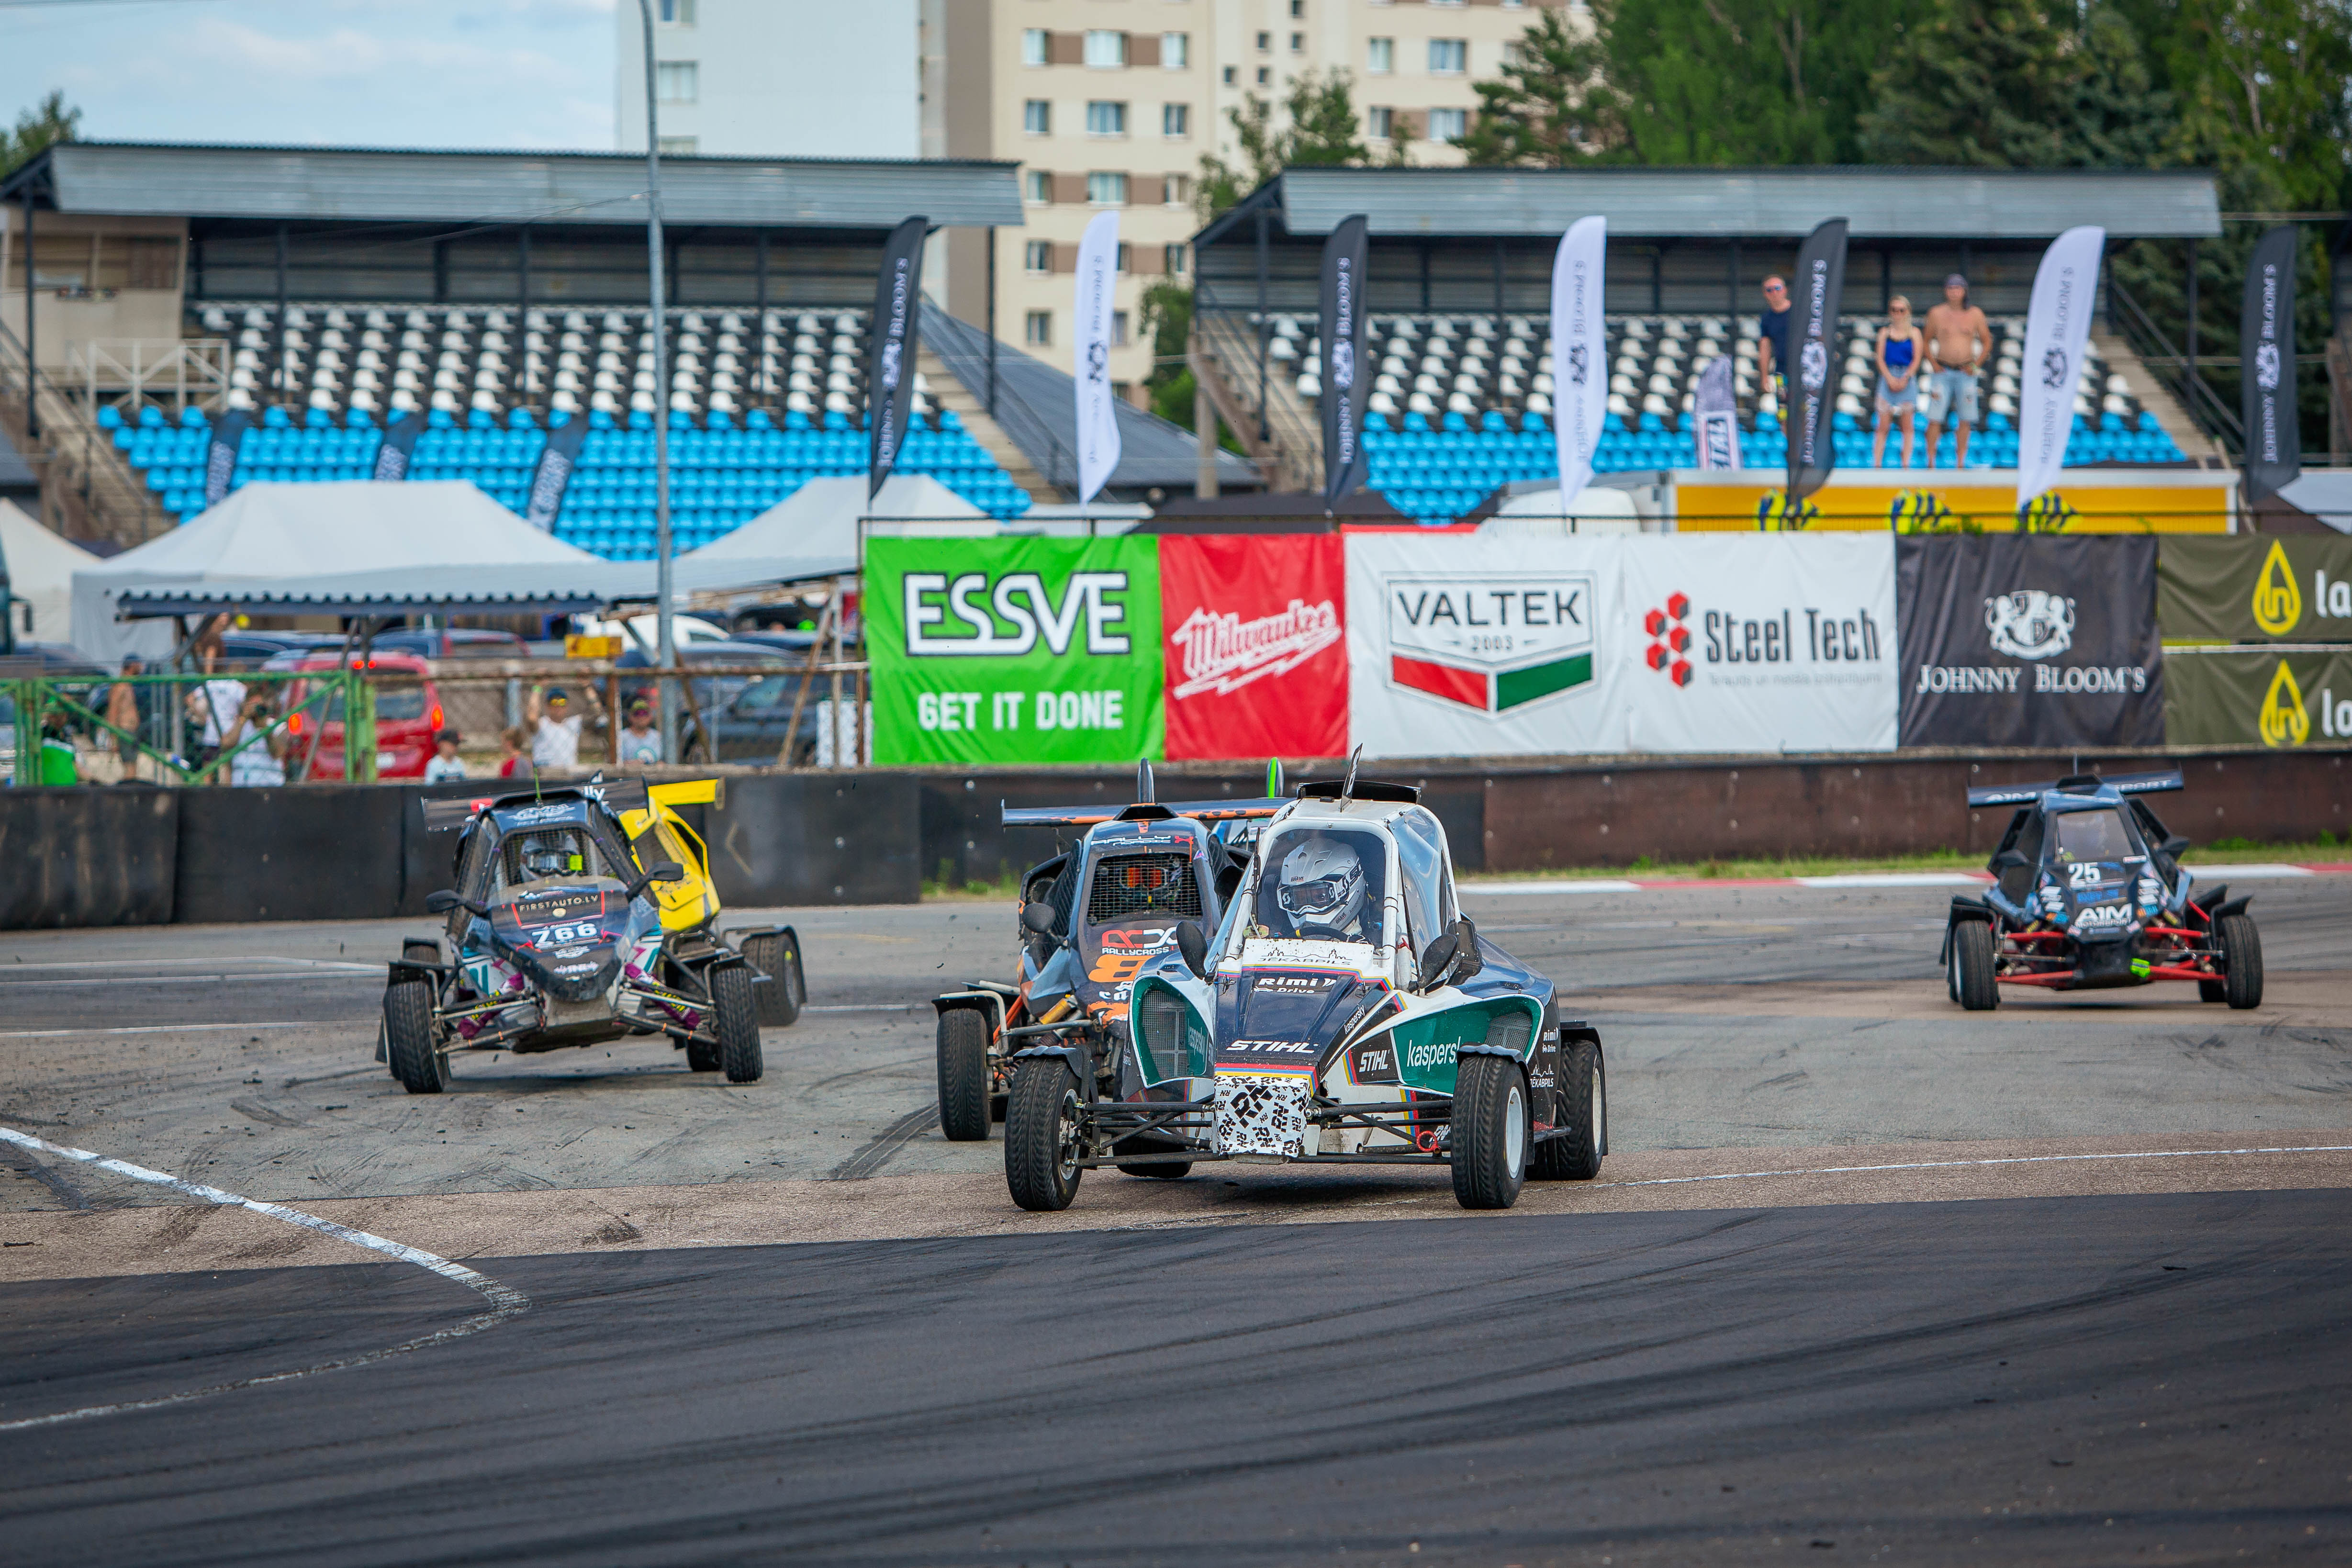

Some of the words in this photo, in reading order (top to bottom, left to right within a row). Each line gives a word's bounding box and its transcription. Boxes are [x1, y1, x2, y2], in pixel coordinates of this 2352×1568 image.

[903, 571, 1131, 656] ESSVE
[1397, 590, 1582, 627] VALTEK
[1171, 599, 1338, 681] Milwaukee
[1705, 608, 1792, 662] Steel
[1804, 607, 1881, 661] Tech
[1916, 664, 2021, 694] JOHNNY
[2034, 663, 2146, 694] BLOOM'S
[918, 692, 982, 731] GET
[993, 691, 1025, 731] IT
[1036, 691, 1123, 730] DONE
[2068, 862, 2101, 885] 25
[519, 895, 598, 913] FIRSTAUTO.LV
[1102, 946, 1170, 956] RALLYCROSS
[1258, 977, 1319, 987] Rimi
[1344, 1004, 1365, 1035] kaspersky
[1226, 1040, 1315, 1053] STIHL
[1359, 1050, 1389, 1073] STIHL
[1407, 1036, 1461, 1072] kaspers
